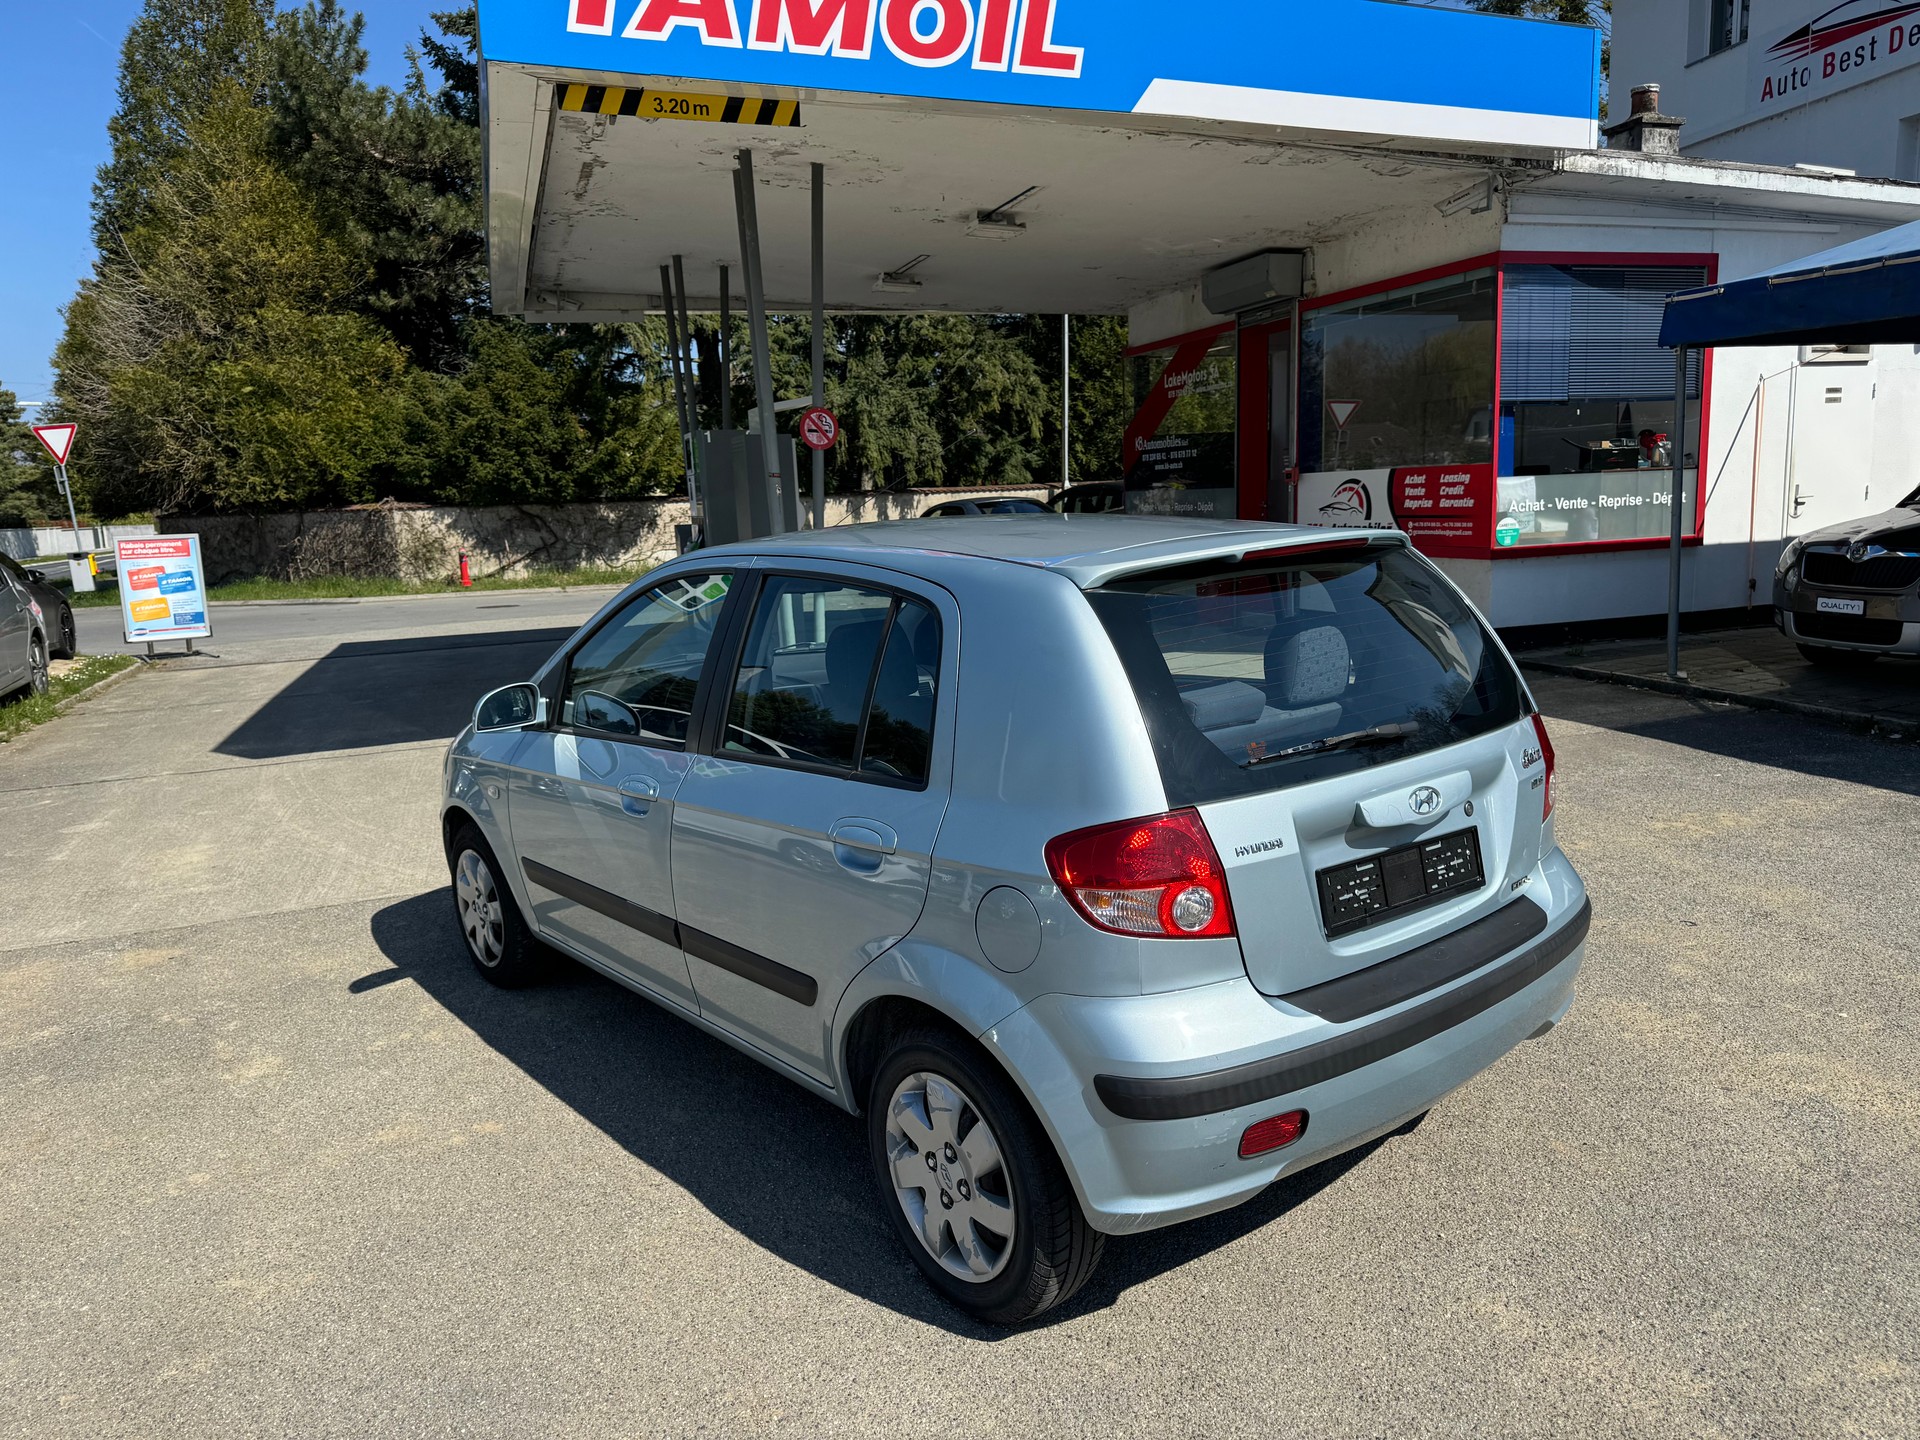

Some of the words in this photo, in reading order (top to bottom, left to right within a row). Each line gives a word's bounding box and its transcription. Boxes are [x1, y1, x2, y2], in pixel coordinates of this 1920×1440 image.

[1760, 66, 1811, 103] Auto
[1822, 35, 1877, 79] Best
[704, 430, 711, 443] 1
[1405, 474, 1427, 485] Achat
[1440, 473, 1471, 485] Leasing
[1404, 486, 1426, 496] Vente
[1174, 501, 1194, 513] Reprise
[1197, 501, 1214, 513] Dépôt
[1404, 499, 1434, 510] Reprise
[1440, 498, 1475, 508] Garantie
[1509, 498, 1545, 513] Achat
[1554, 497, 1588, 510] Vente
[1598, 494, 1643, 509] Reprise
[1653, 491, 1686, 507] Dépt
[134, 547, 159, 555] chaque
[1820, 601, 1856, 611] QUALITY
